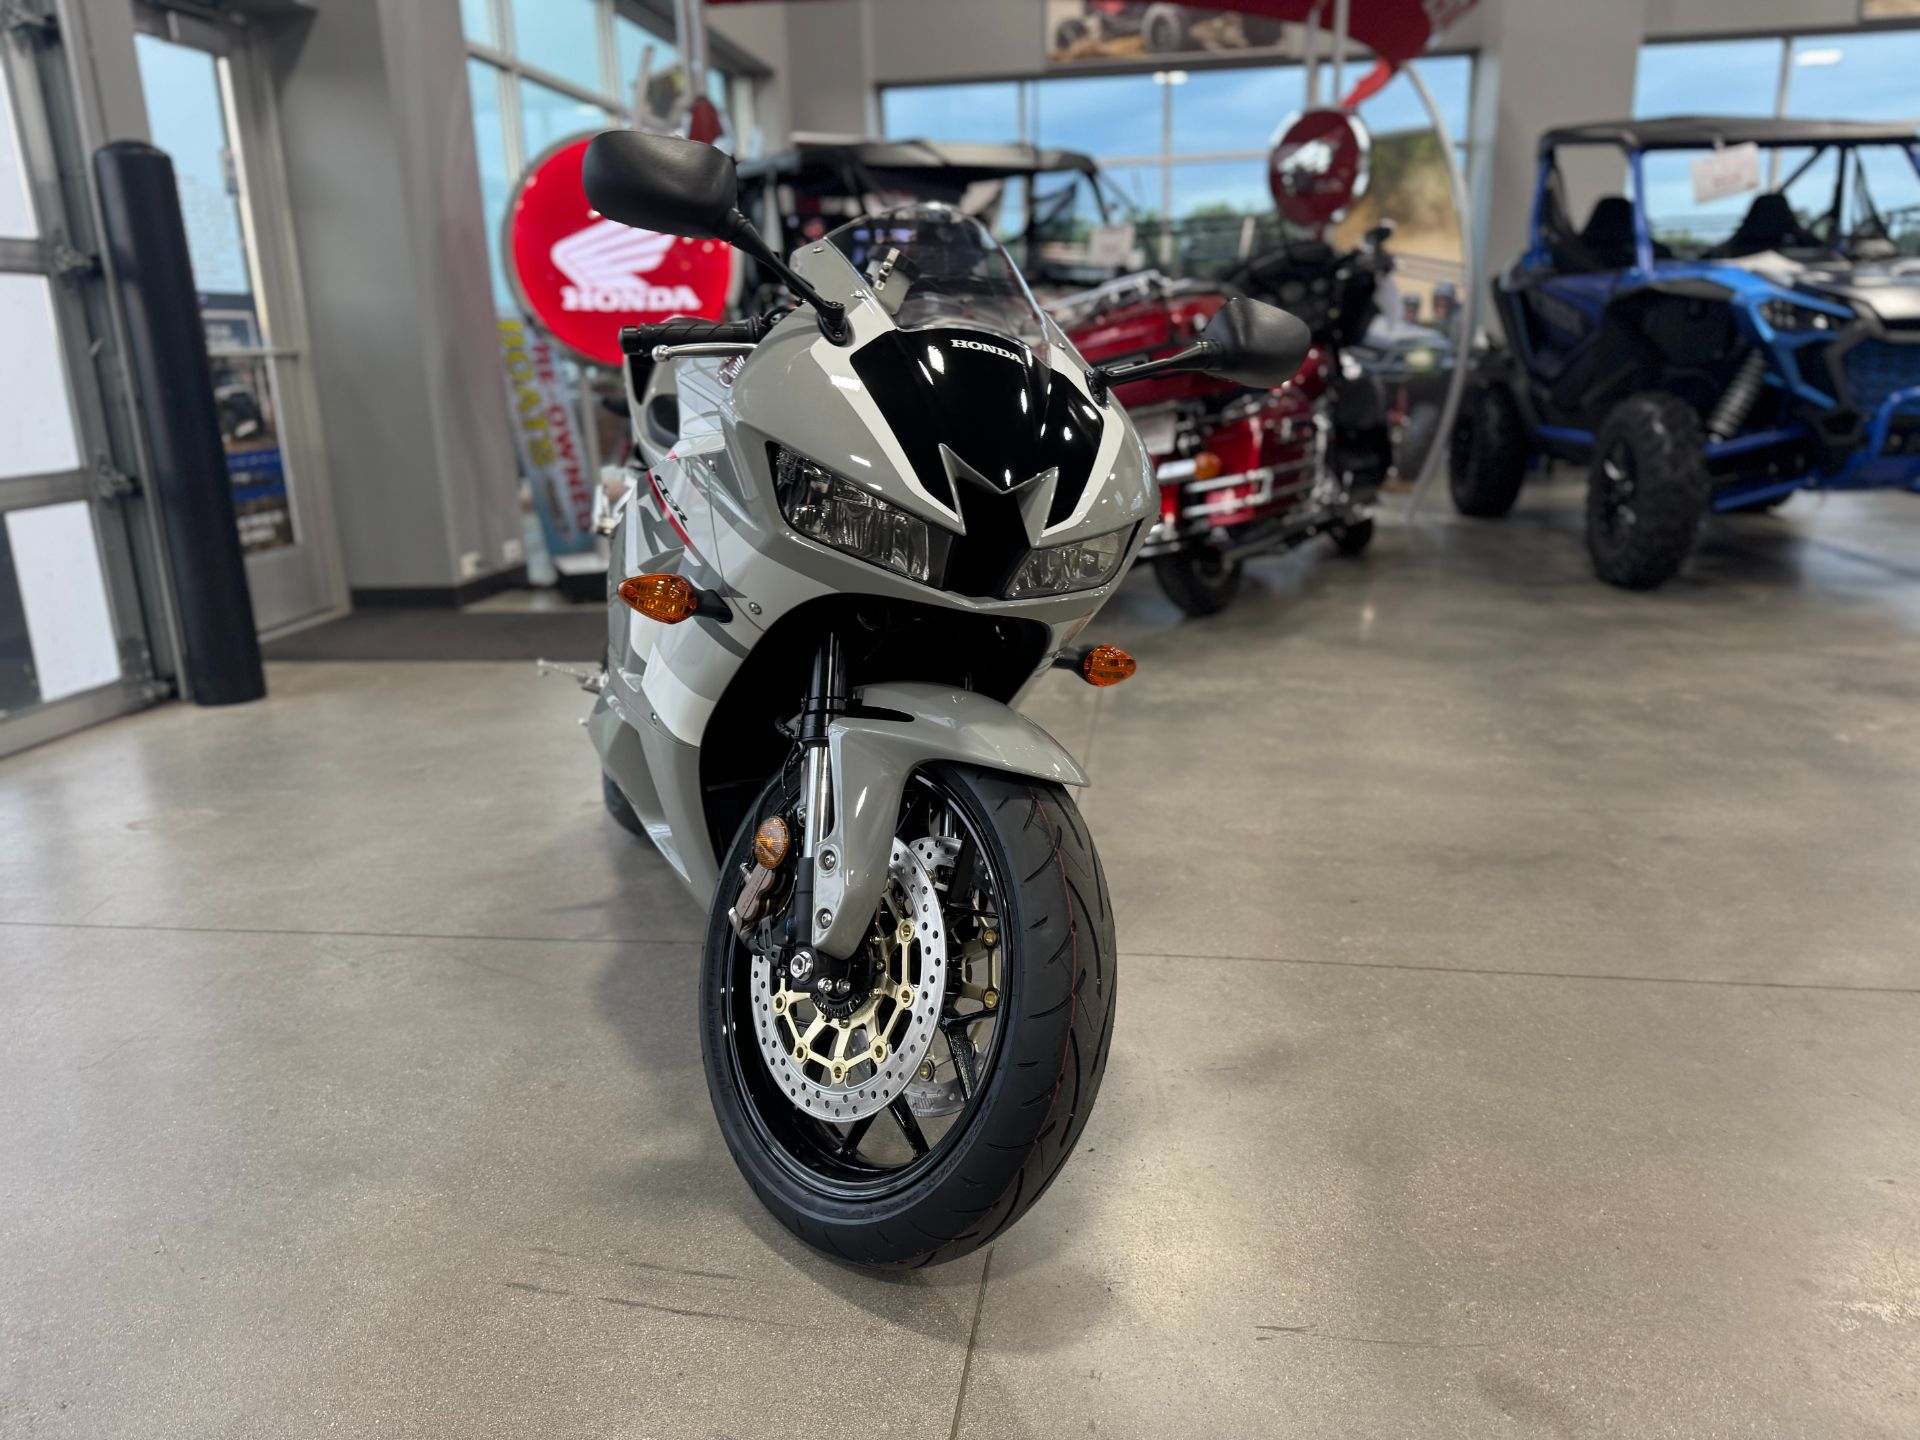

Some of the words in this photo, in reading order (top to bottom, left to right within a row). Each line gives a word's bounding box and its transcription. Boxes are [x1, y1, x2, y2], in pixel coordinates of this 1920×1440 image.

[560, 285, 702, 312] HONDA
[950, 339, 1024, 365] HONDA
[498, 321, 557, 466] BOATS
[653, 474, 689, 531] CBR
